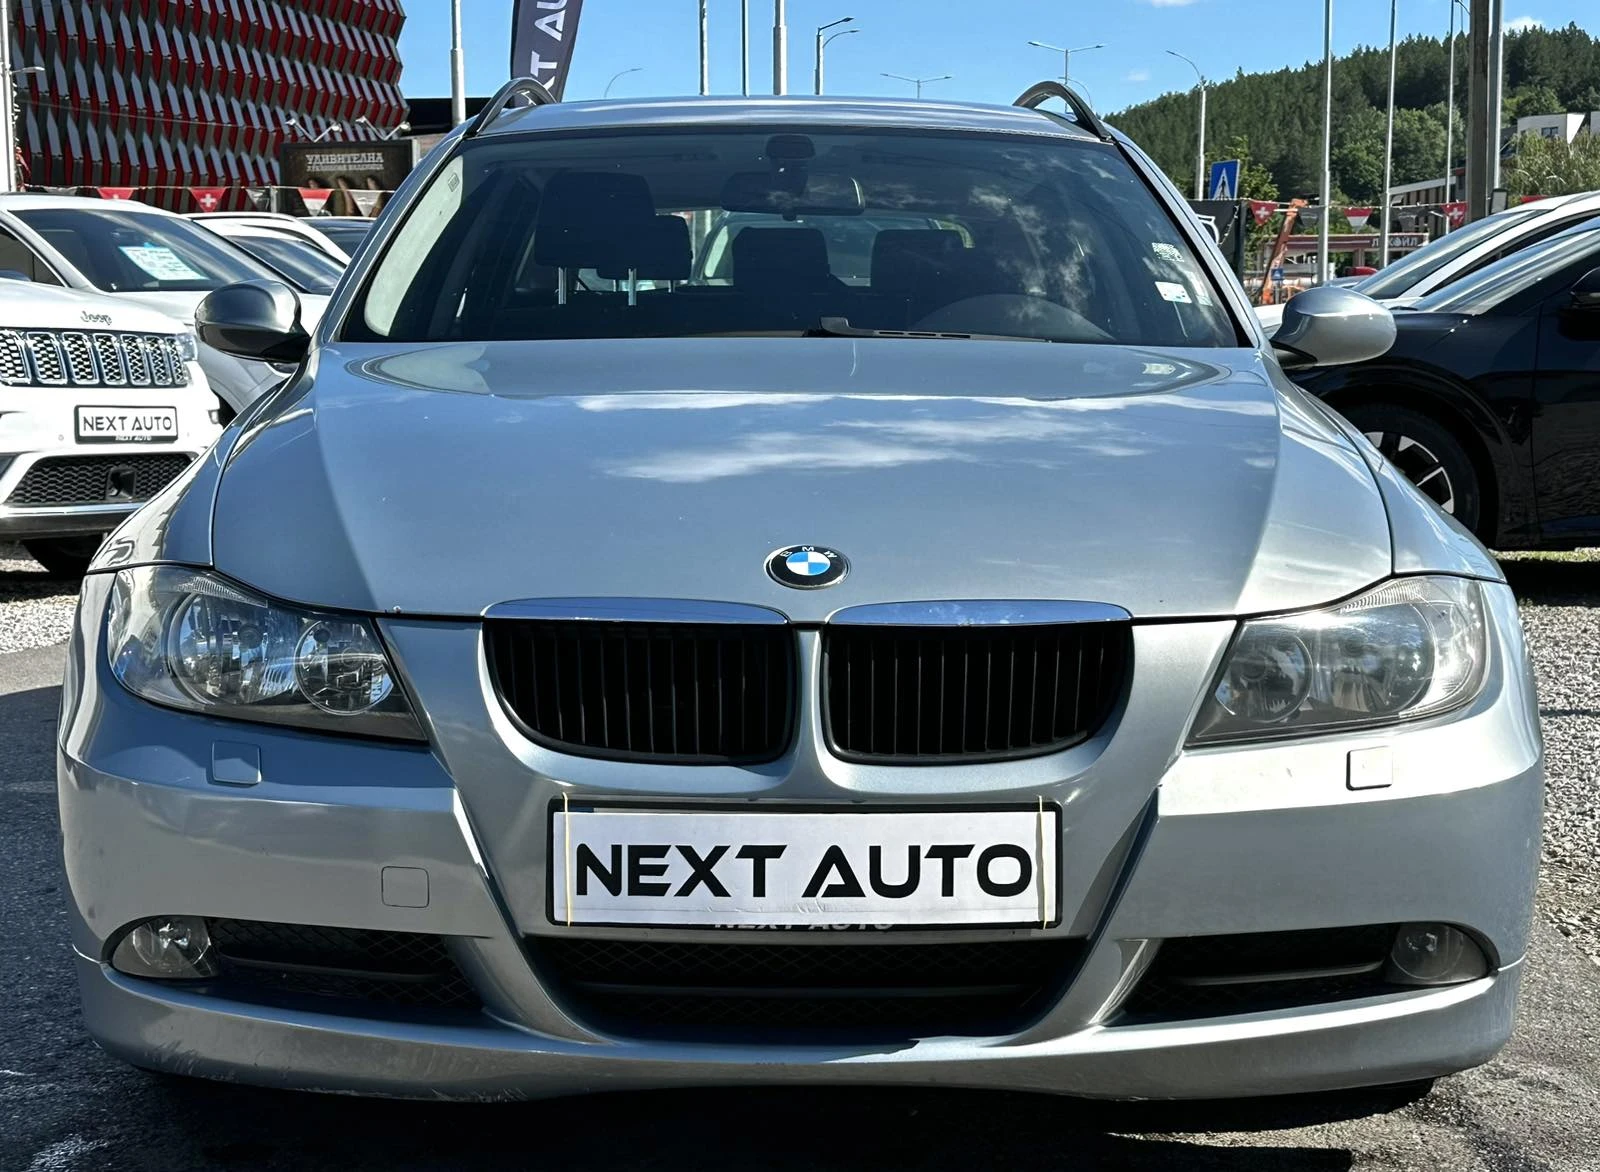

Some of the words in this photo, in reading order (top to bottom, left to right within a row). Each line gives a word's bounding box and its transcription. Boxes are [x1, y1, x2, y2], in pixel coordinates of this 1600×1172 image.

[1371, 236, 1418, 247] ЛКОЙЛ
[79, 310, 113, 326] Jeep
[83, 416, 128, 431] NEXT
[131, 416, 172, 431] AUTO
[576, 843, 787, 898] NEXT
[802, 843, 1033, 898] AUTO
